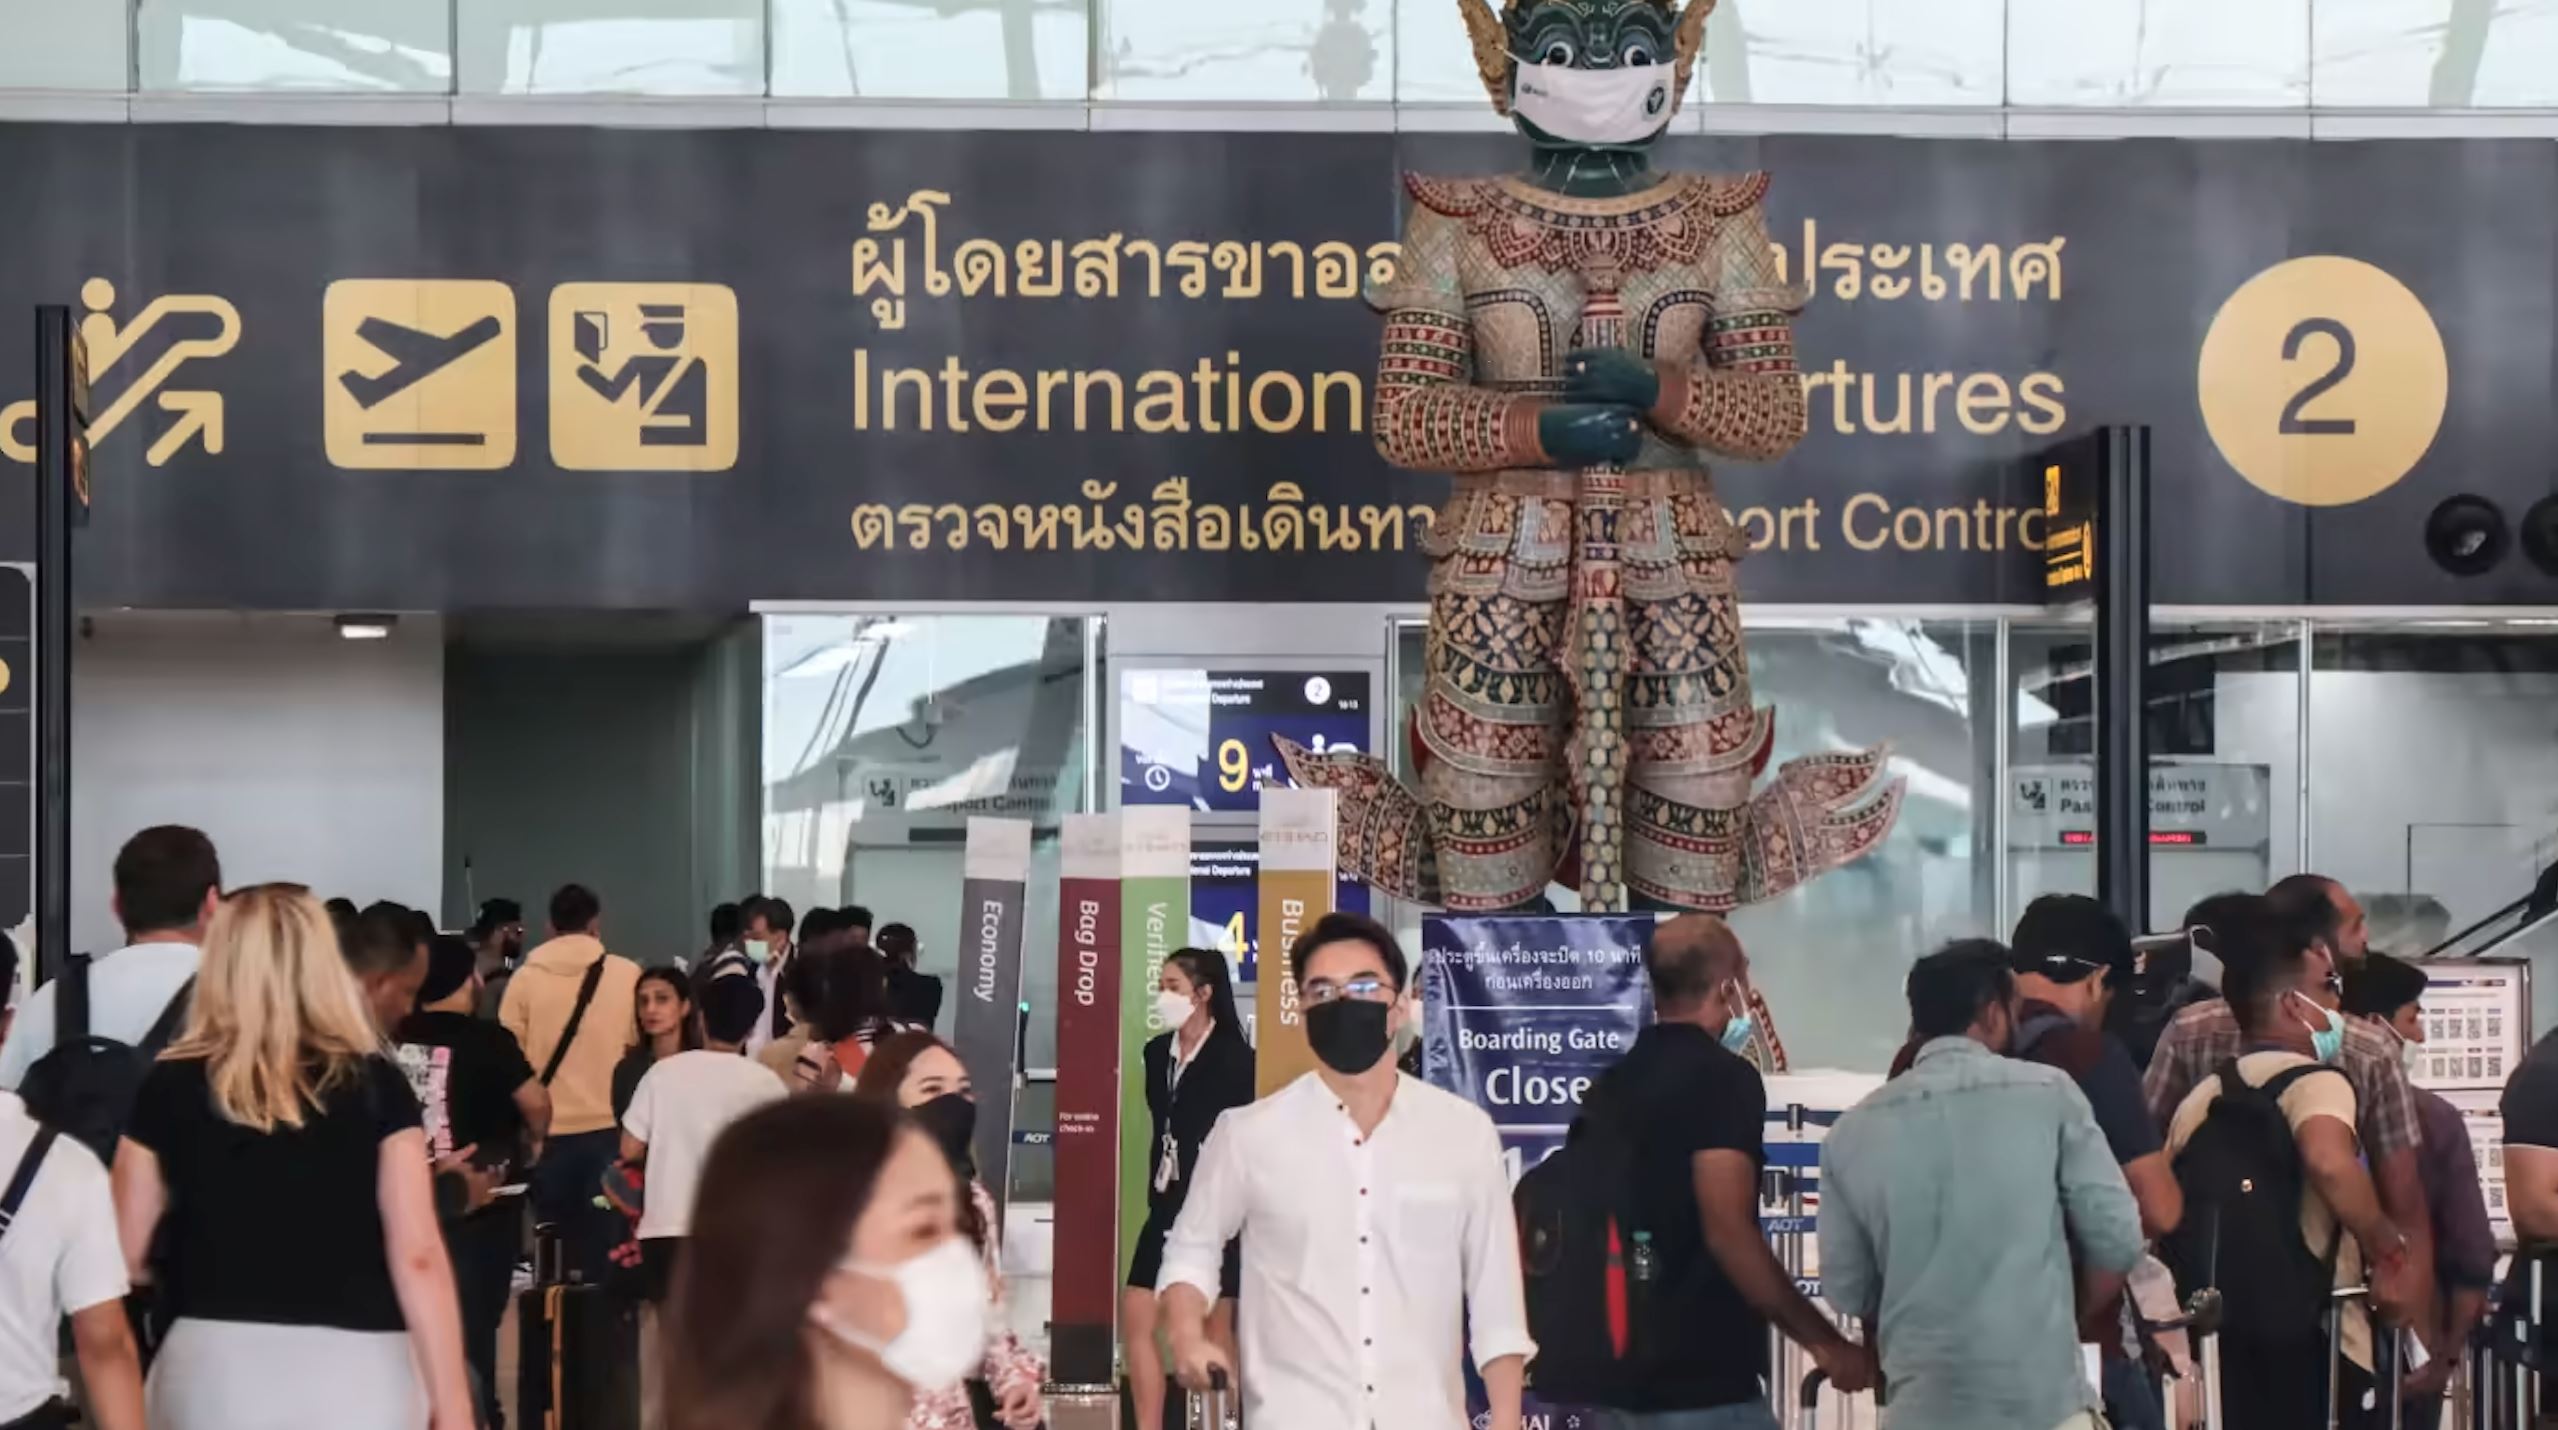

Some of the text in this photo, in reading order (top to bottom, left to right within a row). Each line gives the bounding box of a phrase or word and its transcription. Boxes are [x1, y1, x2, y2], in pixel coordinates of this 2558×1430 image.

[854, 349, 1363, 433] Internation
[2278, 317, 2356, 434] 2
[1722, 498, 1820, 550] ort
[1218, 738, 1249, 792] 9
[973, 900, 1004, 1003] Economy
[1073, 900, 1099, 1006] Bag Drop
[1217, 911, 1249, 963] 4
[1459, 1027, 1620, 1054] Boarding Gate
[1485, 1065, 1593, 1105] Close
[1023, 1132, 1051, 1144] AOT
[1767, 1218, 1805, 1232] AOT
